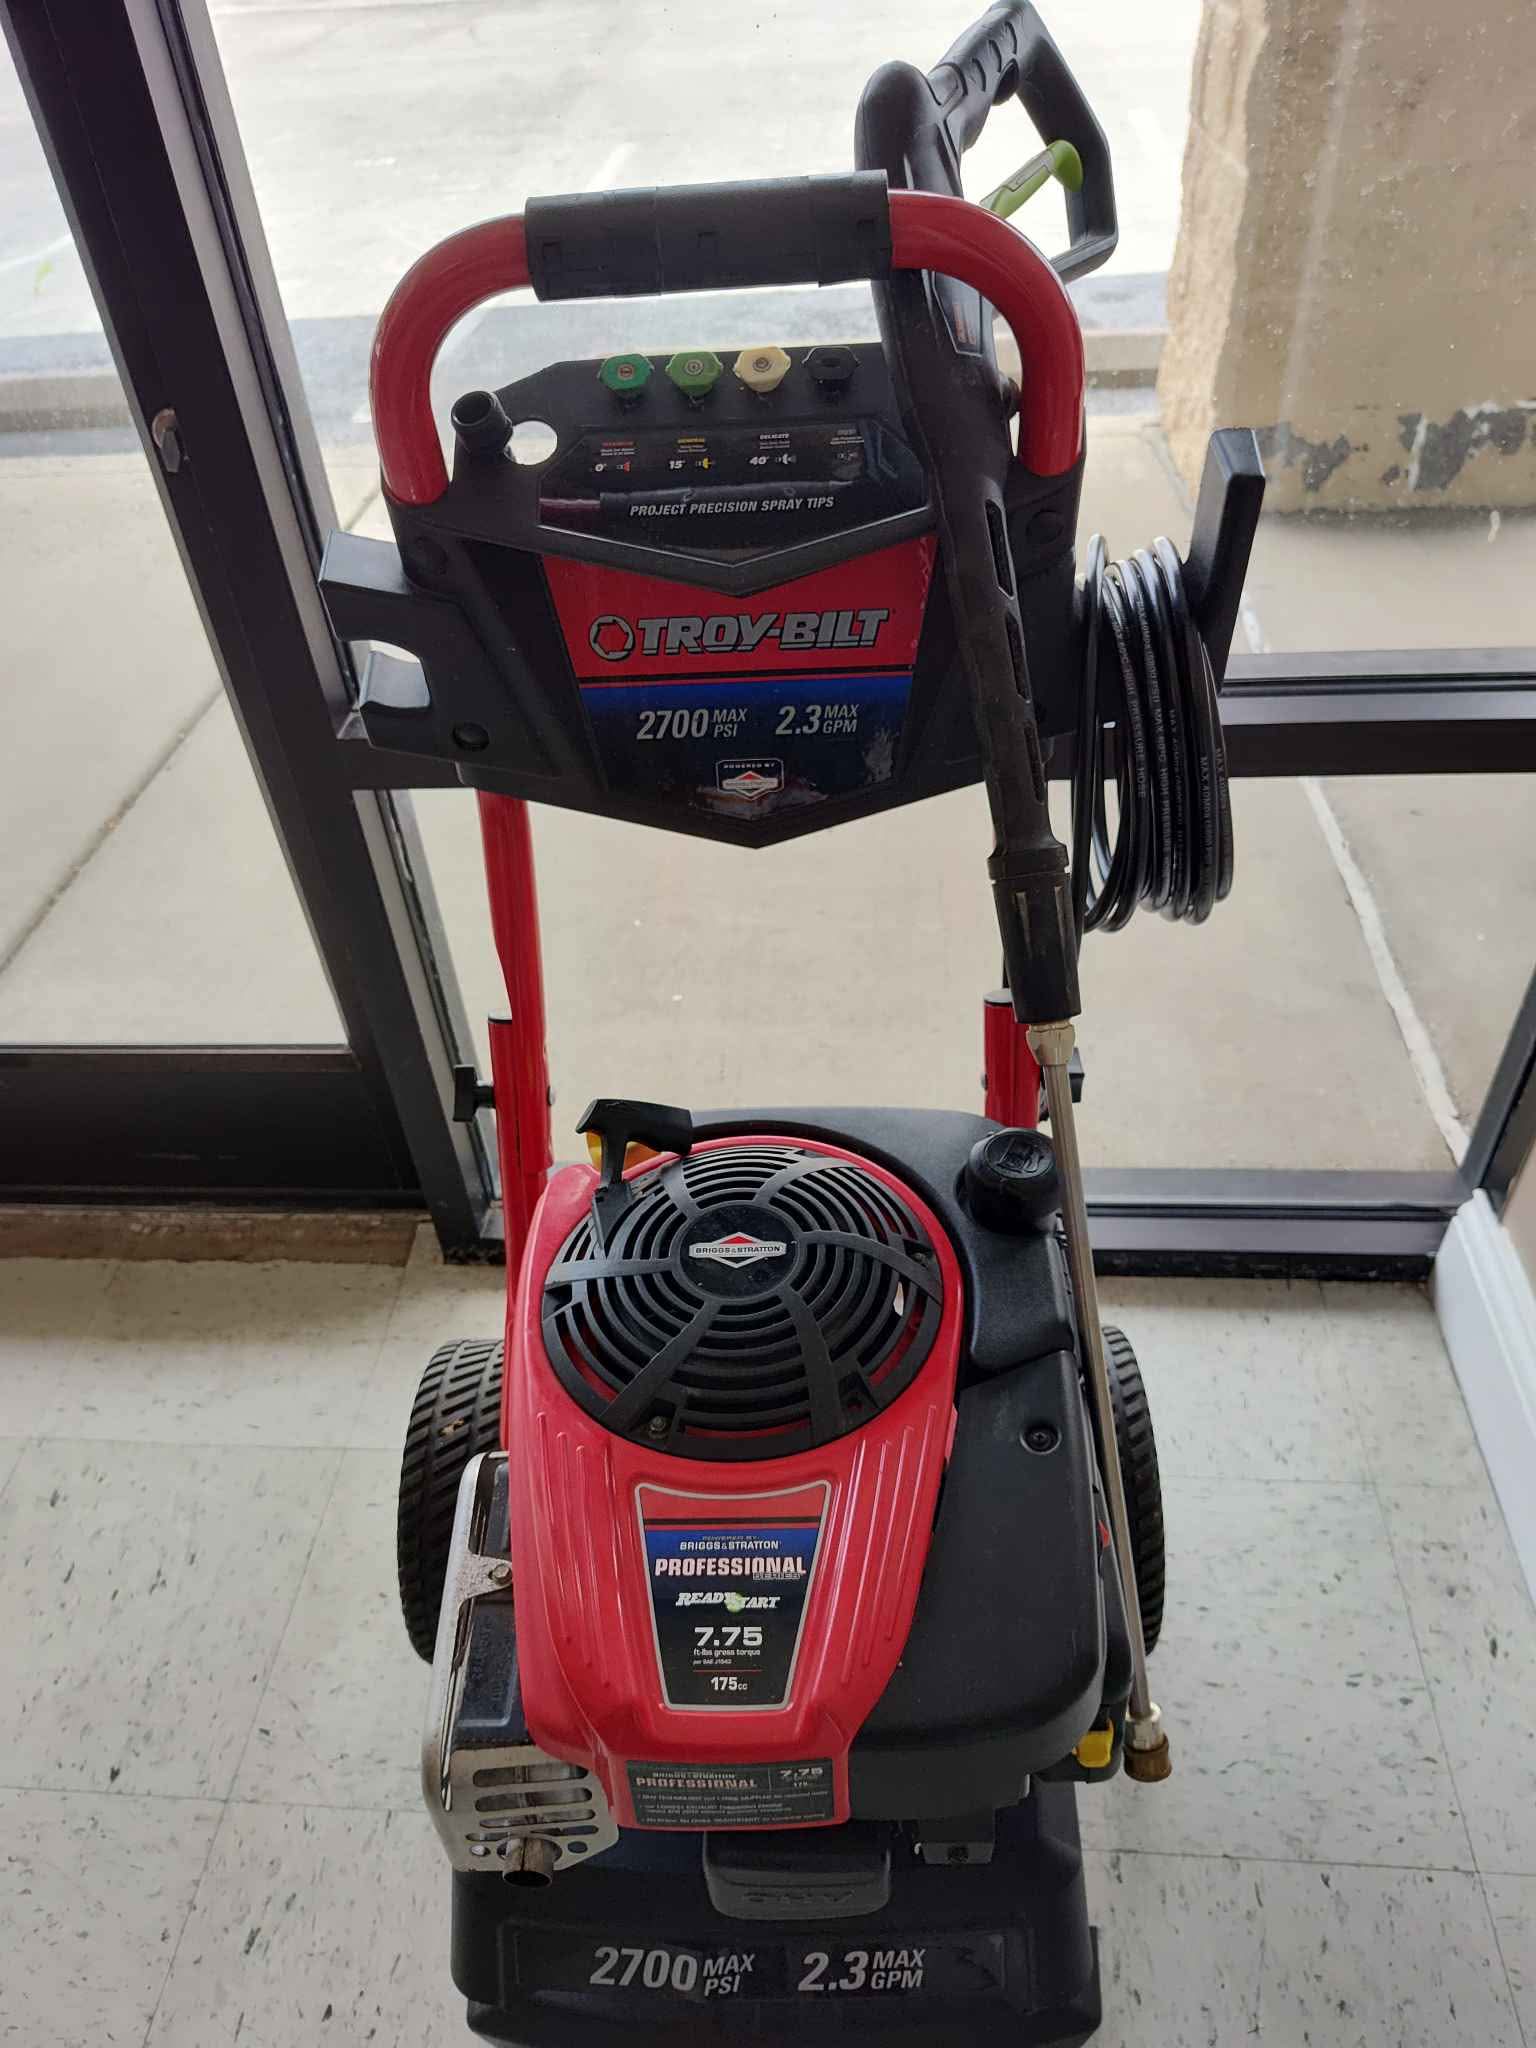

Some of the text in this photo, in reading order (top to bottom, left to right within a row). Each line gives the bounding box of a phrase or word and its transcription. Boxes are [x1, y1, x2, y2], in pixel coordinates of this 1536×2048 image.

[630, 497, 834, 516] PROJECT PRECISION SPRAY TIPS
[637, 609, 889, 656] TROY-BILT
[636, 708, 748, 740] 2700 MAX
[775, 704, 861, 735] 2.3 MAX
[822, 718, 858, 734] GPM
[713, 723, 738, 738] PSI
[654, 1557, 807, 1576] PROFESSIONAL
[694, 1626, 763, 1646] 7.75
[714, 1649, 735, 1658] gross
[736, 1648, 761, 1657] torque
[636, 1778, 757, 1789] PROFESSIONAL
[590, 1946, 755, 1992] 2700 MAX
[798, 1949, 926, 1992] 2.3 MAX
[703, 1974, 741, 1997] PSI
[870, 1969, 923, 1990] GPM
